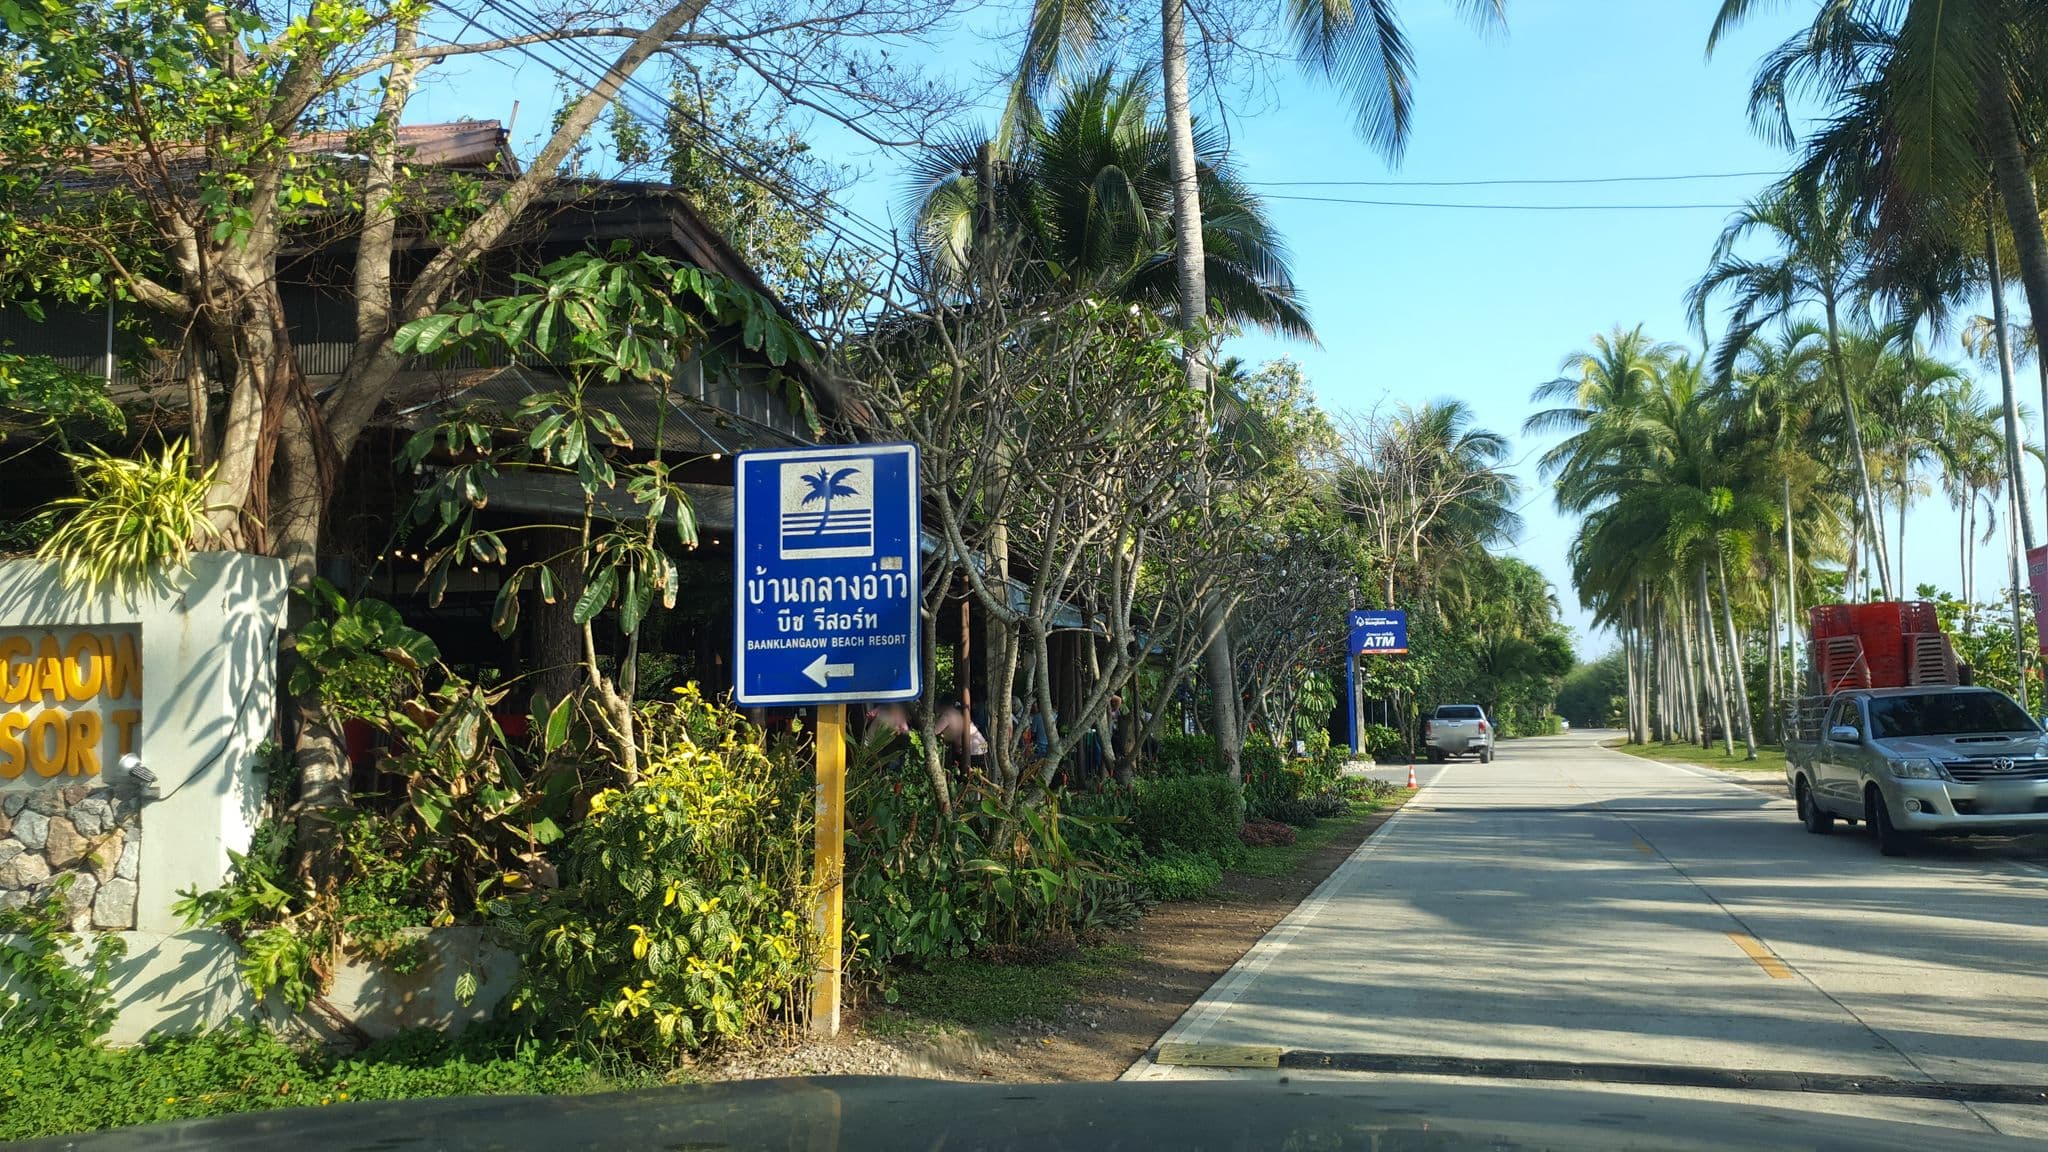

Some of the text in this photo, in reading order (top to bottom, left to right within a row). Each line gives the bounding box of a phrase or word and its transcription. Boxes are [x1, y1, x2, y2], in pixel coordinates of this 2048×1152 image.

[748, 562, 908, 604] บ้านกลางอ่าว
[777, 607, 878, 632] บีช รีสอร์ท
[748, 634, 906, 650] BAANKLANGAOW BEACH RESORT
[1363, 636, 1396, 648] ATM
